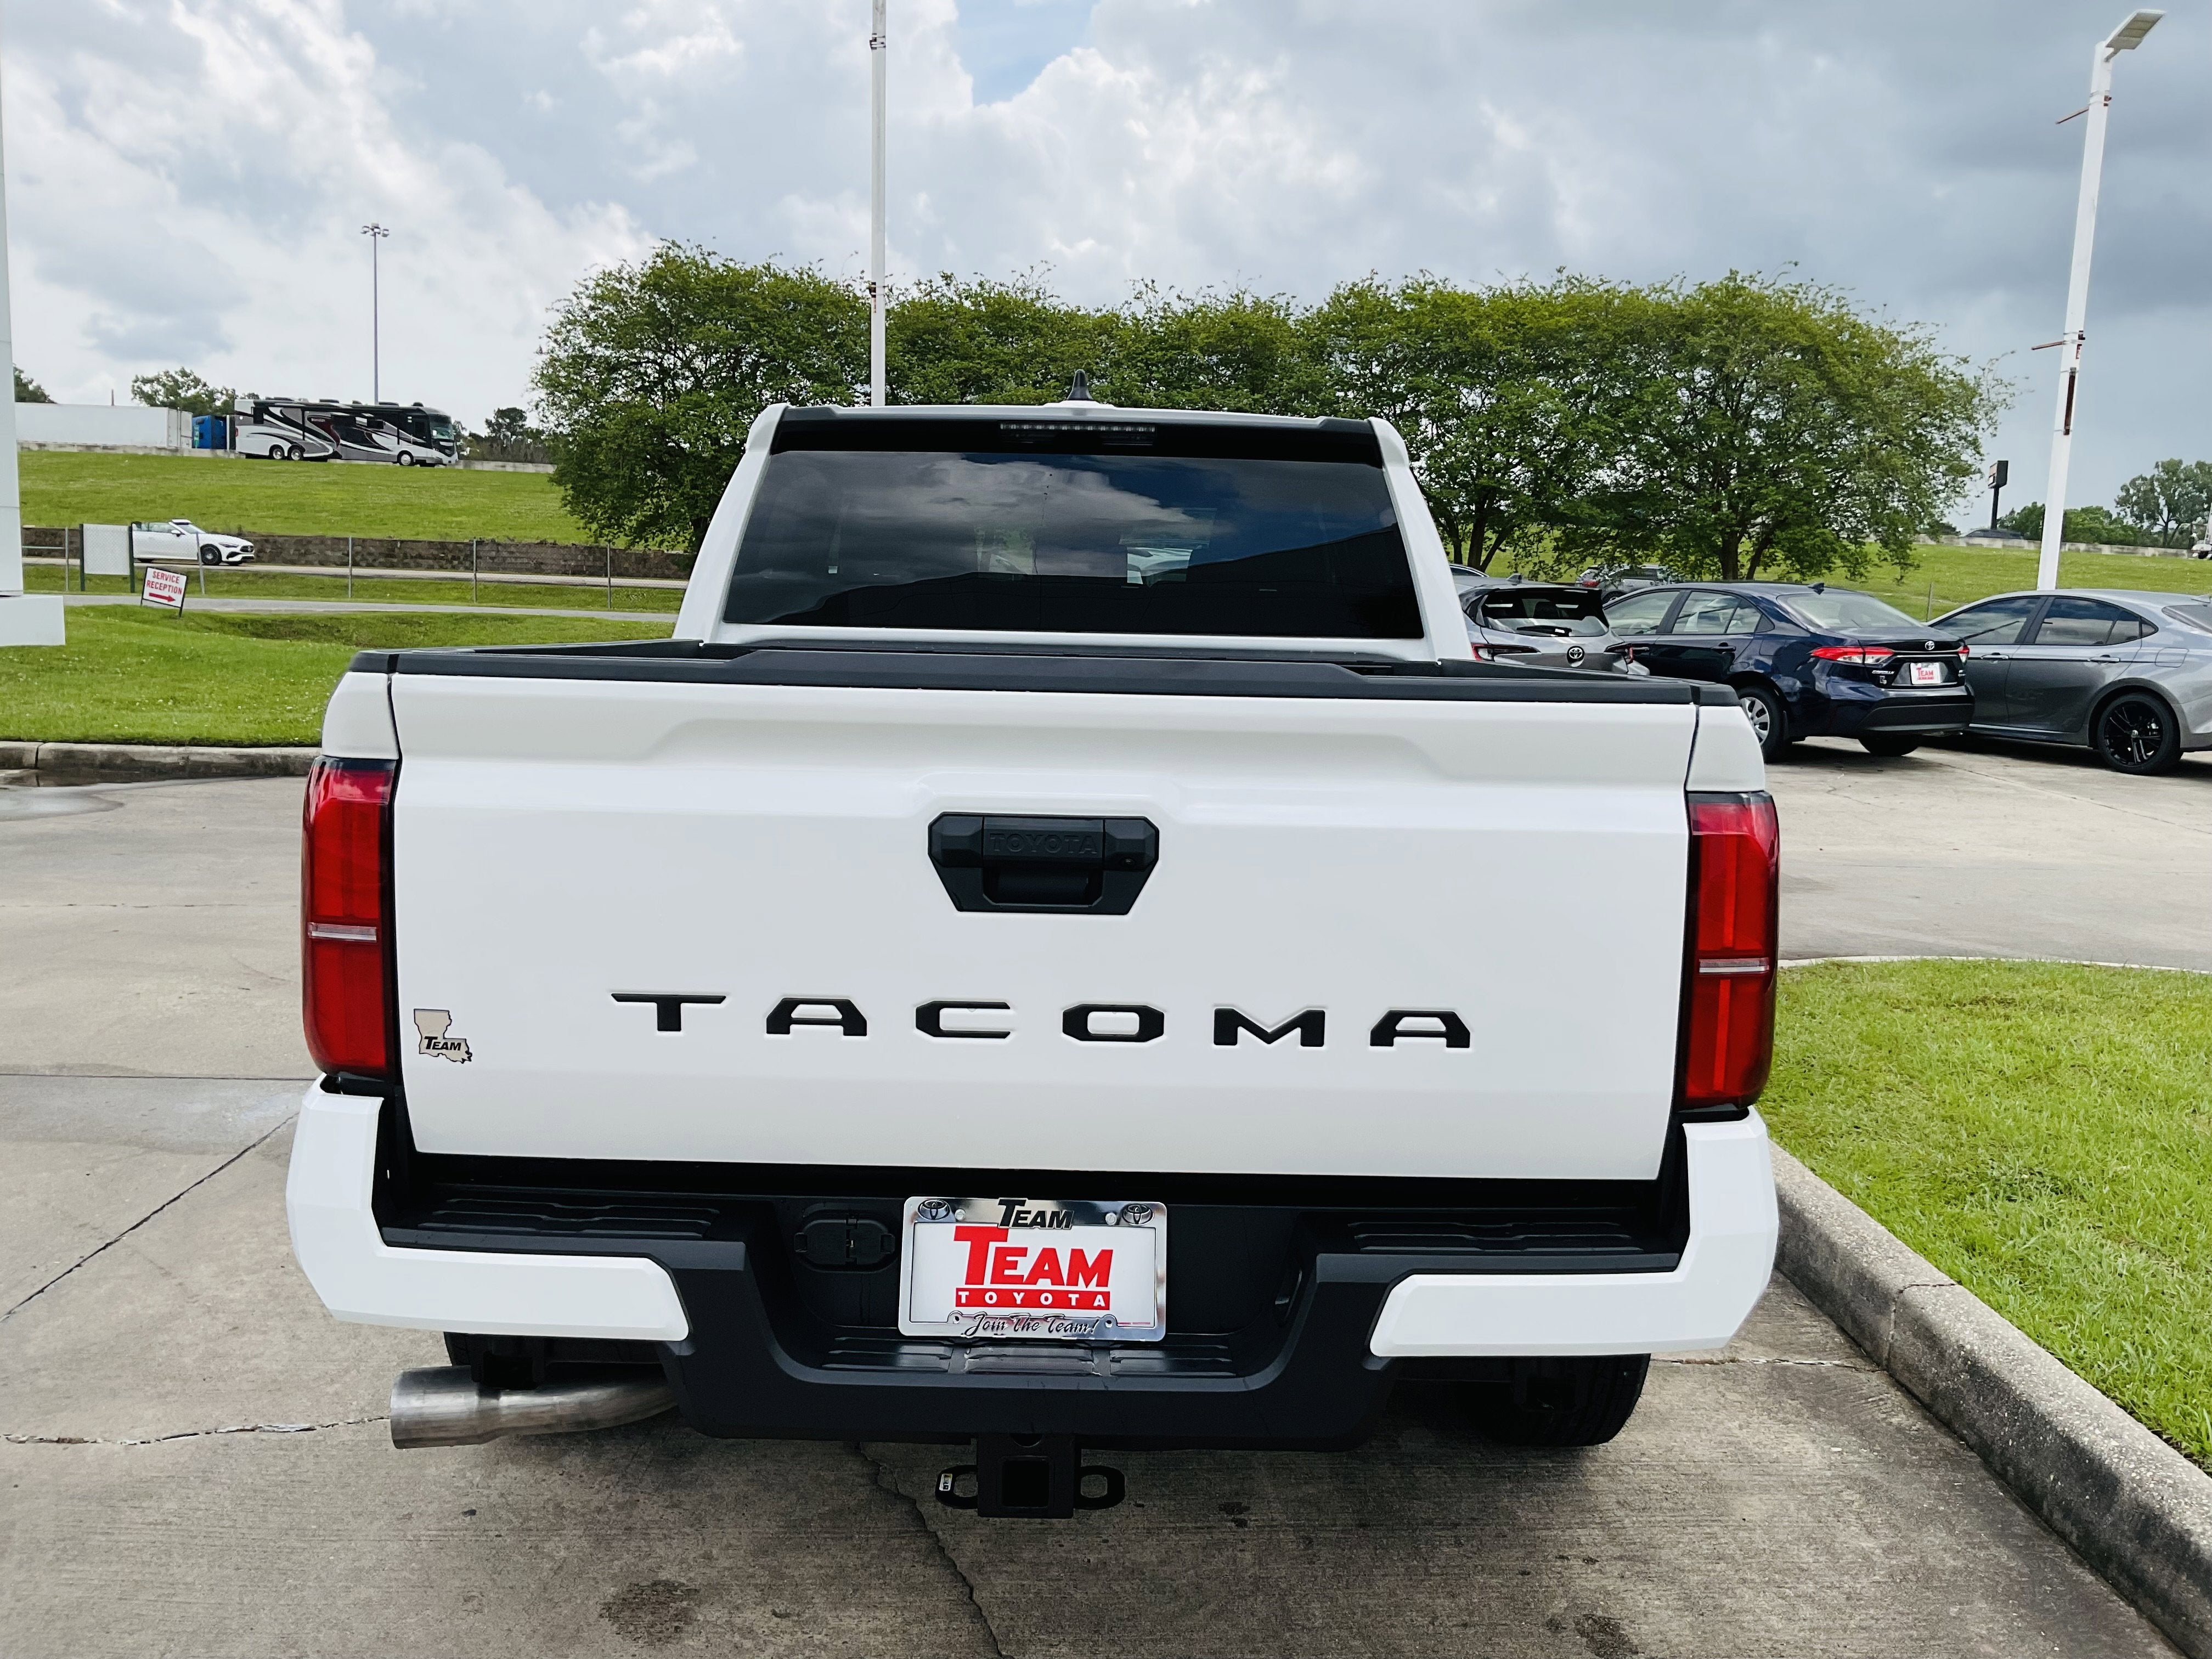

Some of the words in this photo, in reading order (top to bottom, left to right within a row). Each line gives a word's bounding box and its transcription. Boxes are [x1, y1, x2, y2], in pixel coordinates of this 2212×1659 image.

[146, 580, 183, 594] RECEPTION
[153, 571, 180, 584] SERVICE
[1916, 667, 1934, 676] TEAM
[989, 832, 1097, 854] TOYOTA
[610, 993, 1471, 1049] TACOMA
[424, 1036, 461, 1051] TEAM
[998, 1198, 1074, 1229] TEAM
[953, 1225, 1114, 1289] TEAM
[957, 1290, 1106, 1307] TOYOTA
[961, 1312, 1007, 1338] Join
[1009, 1313, 1041, 1332] The
[1043, 1314, 1100, 1334] Team!
